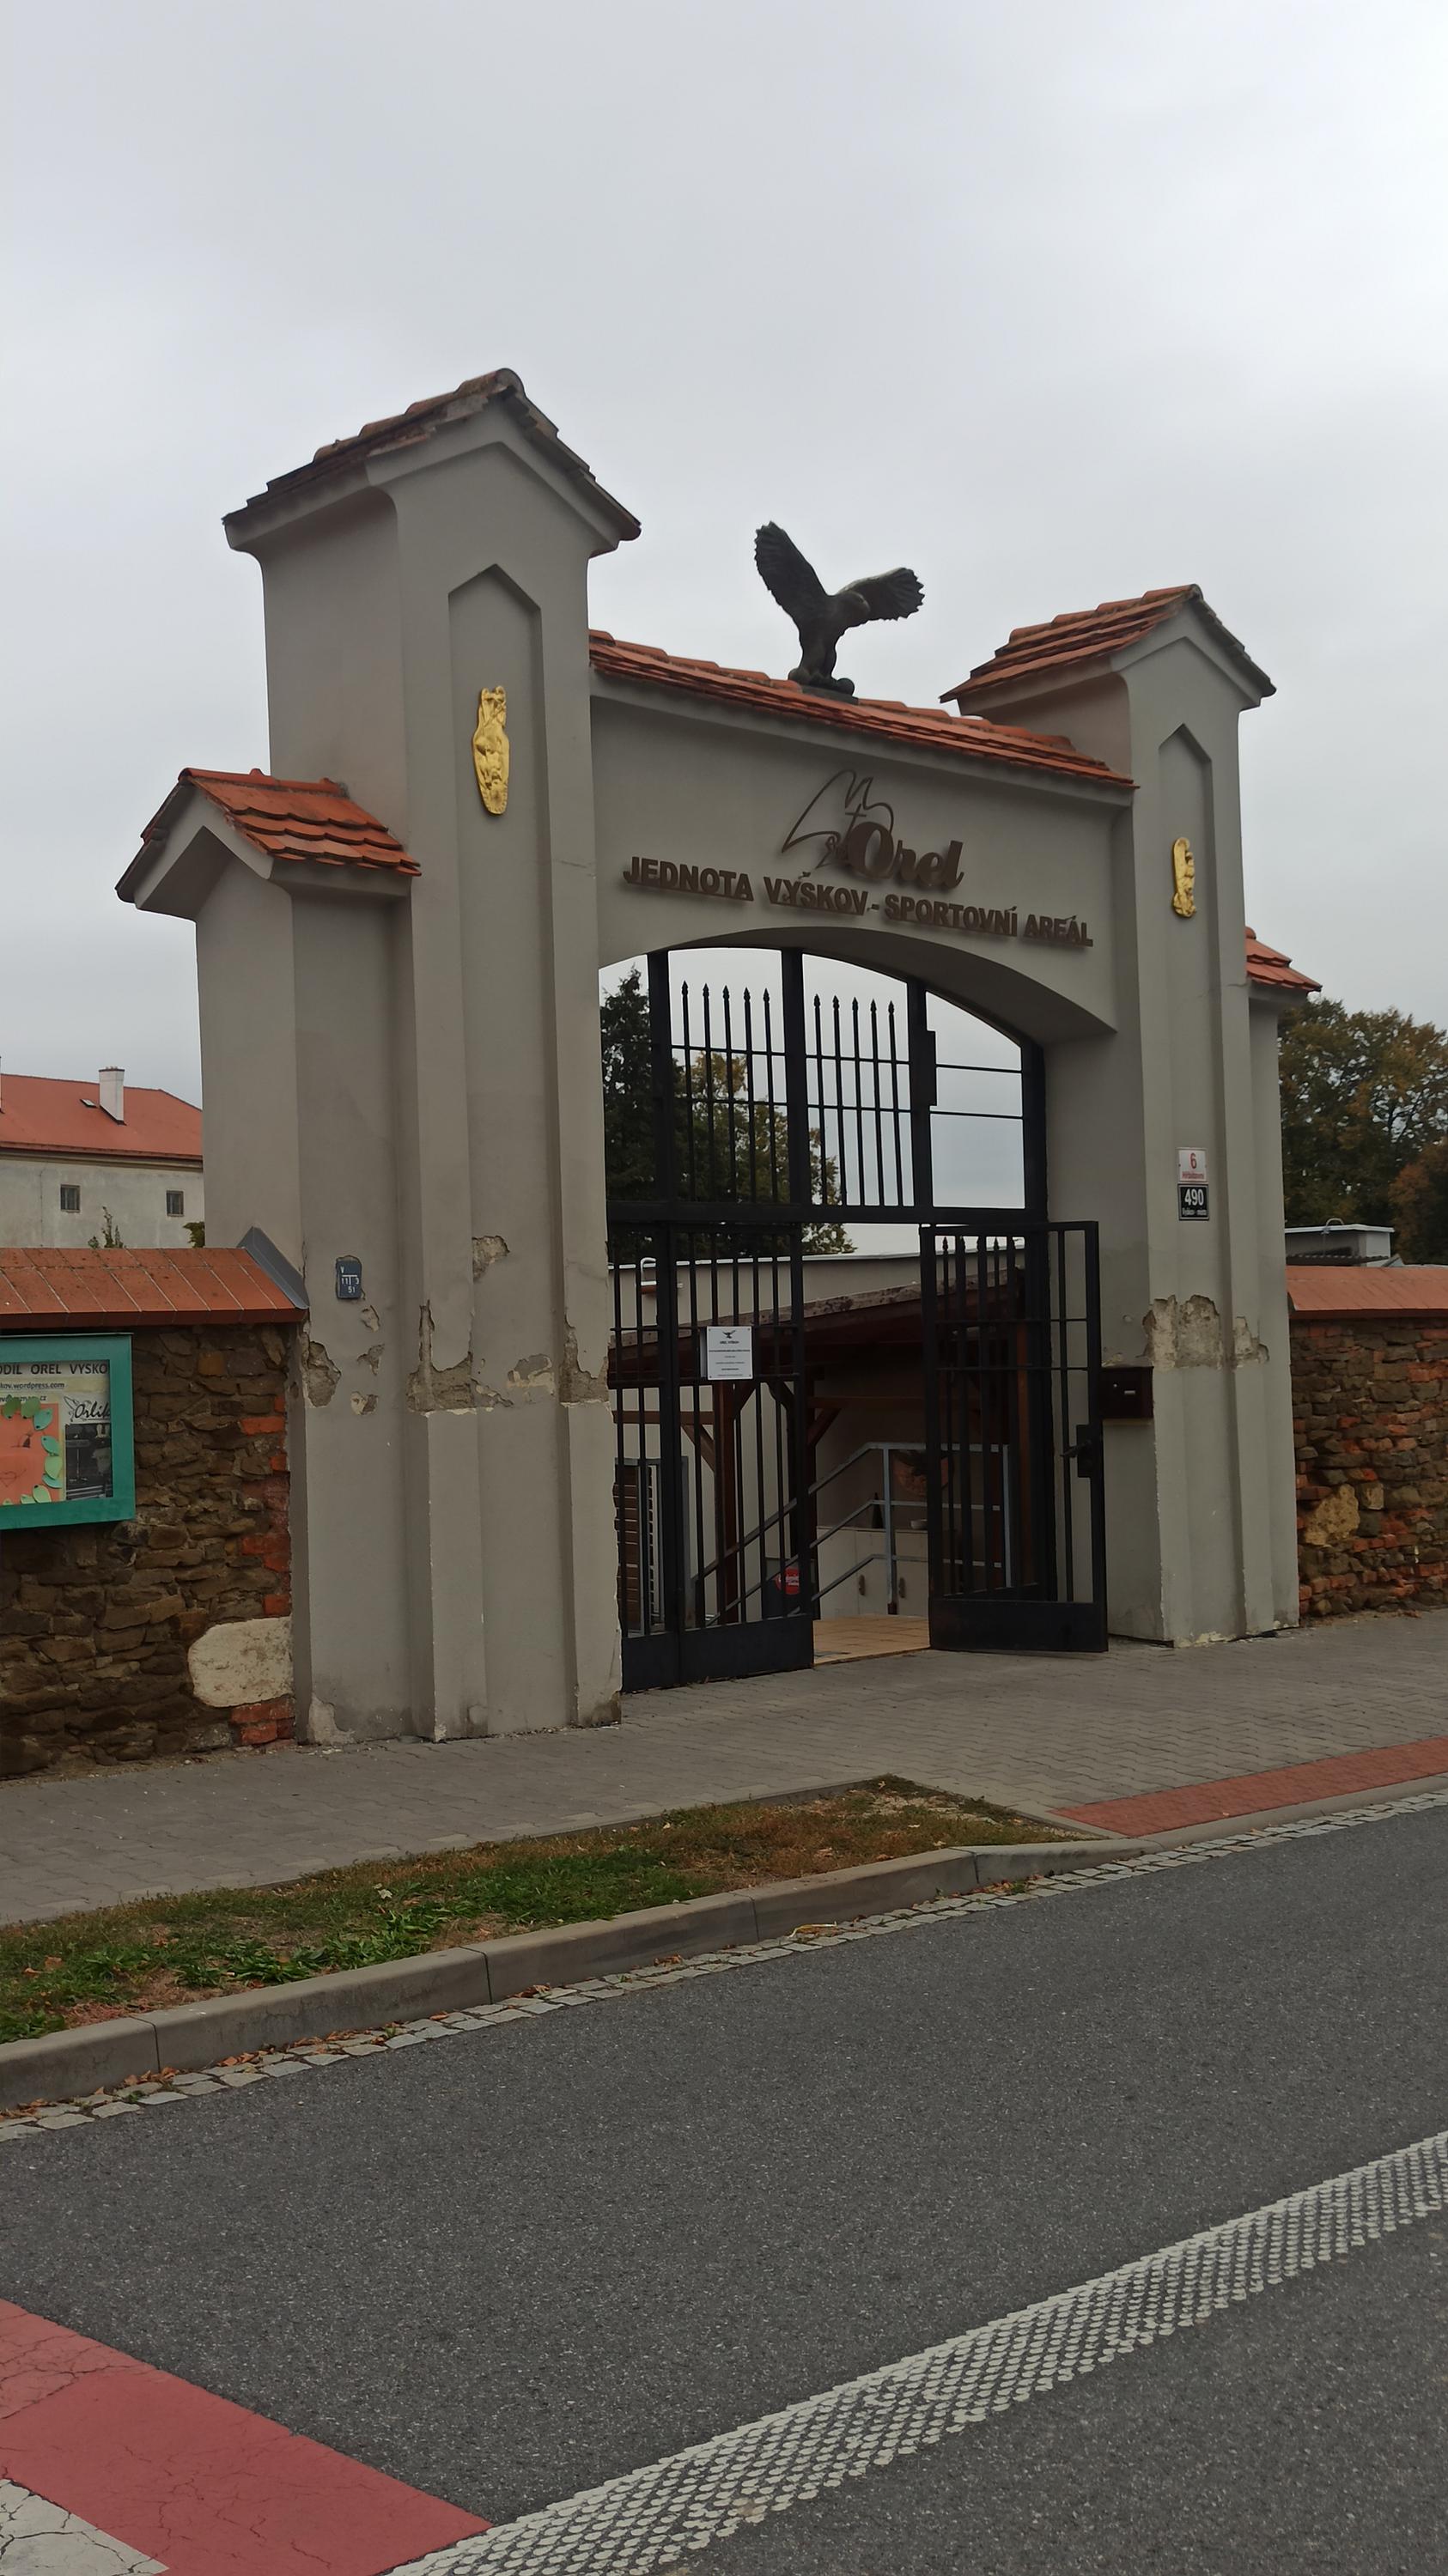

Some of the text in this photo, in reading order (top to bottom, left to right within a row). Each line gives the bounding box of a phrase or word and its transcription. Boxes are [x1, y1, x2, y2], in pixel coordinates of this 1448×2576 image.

[845, 822, 964, 889] Orel
[623, 856, 754, 902] JEDNOTA
[1023, 914, 1093, 947] AREÁL
[1189, 1152, 1197, 1169] 6
[1184, 1188, 1204, 1206] 490
[0, 1364, 22, 1375] DIL
[30, 1364, 62, 1375] OREL
